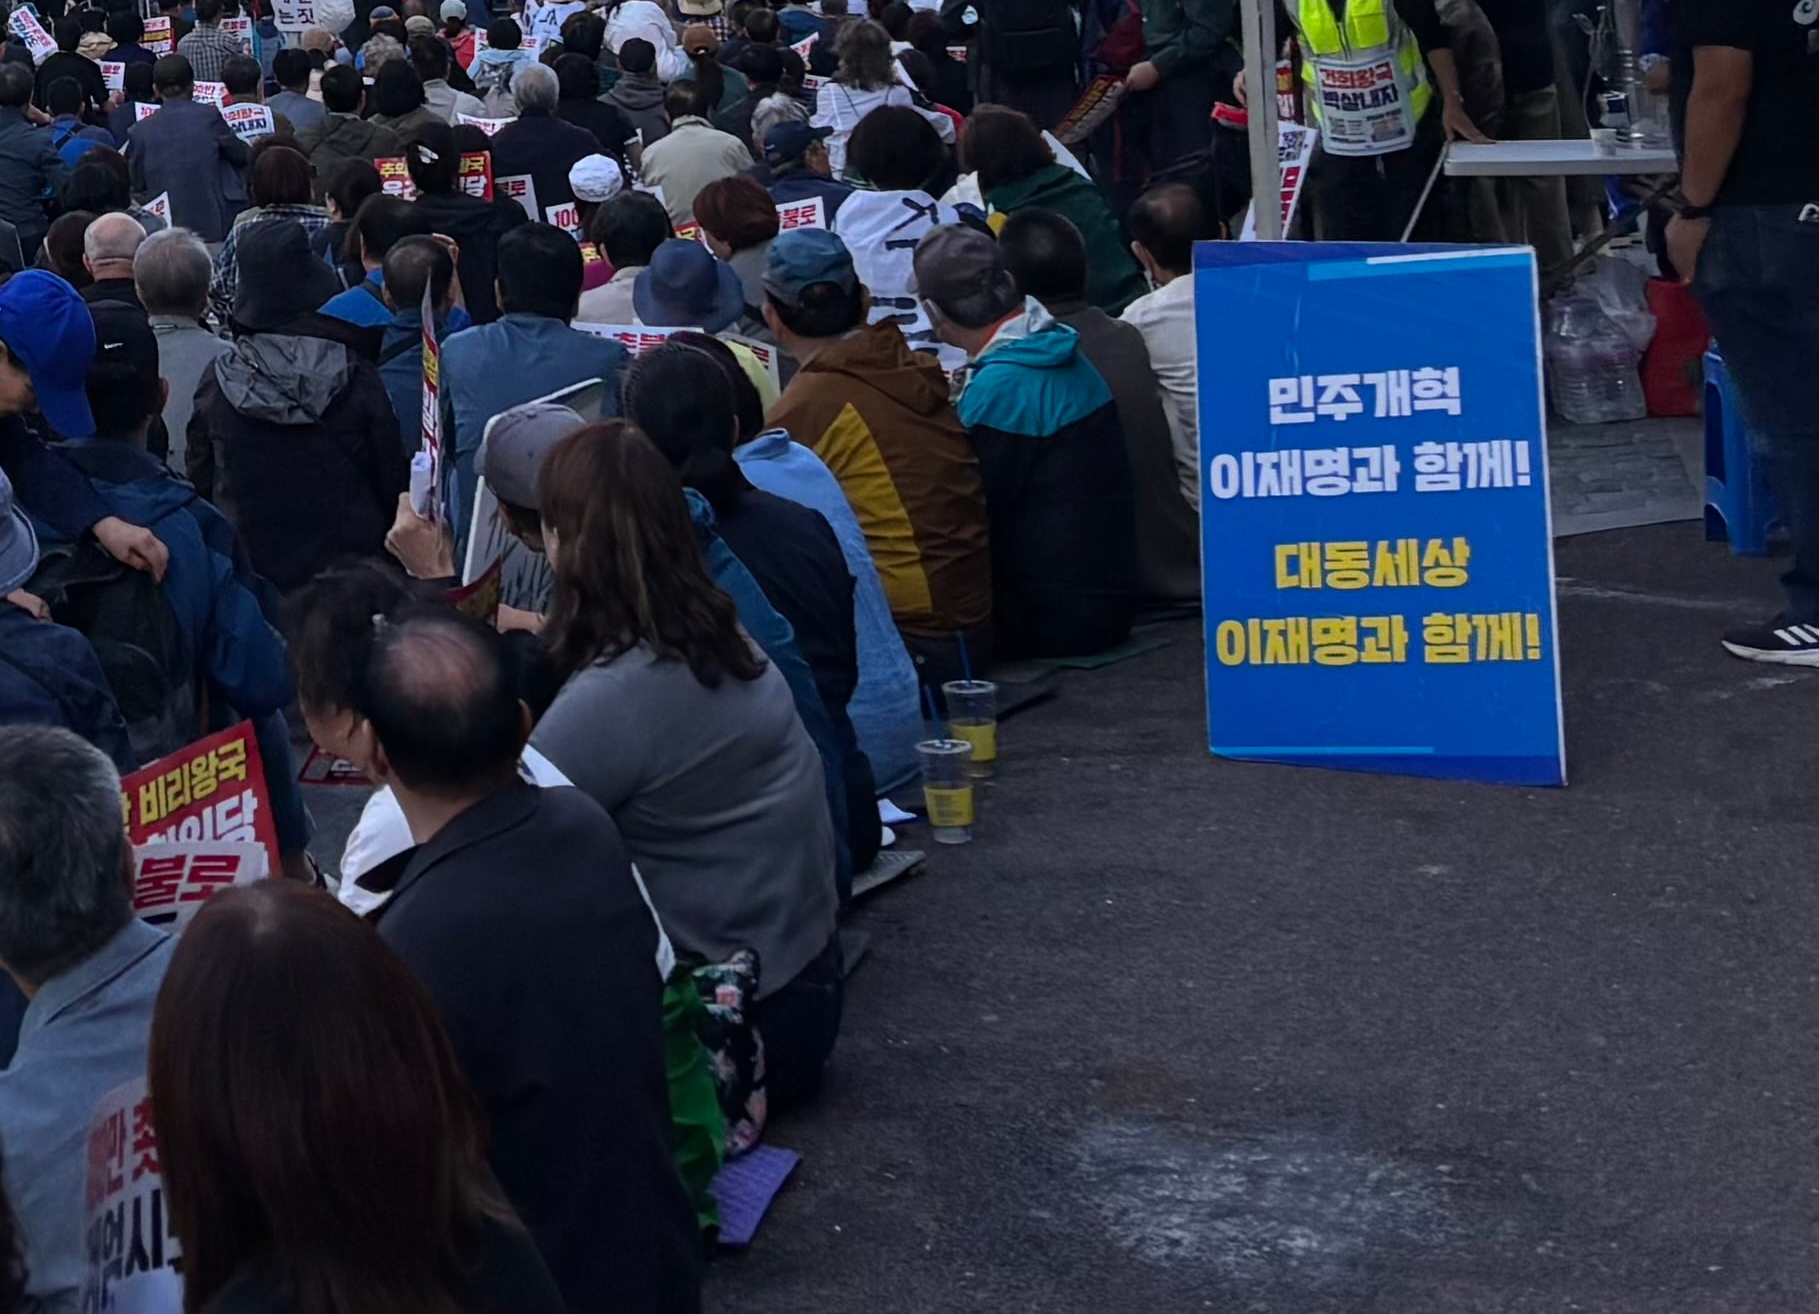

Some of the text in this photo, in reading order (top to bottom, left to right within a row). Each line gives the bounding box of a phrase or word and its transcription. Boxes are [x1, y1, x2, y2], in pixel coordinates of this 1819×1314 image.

[1268, 367, 1461, 425] 민주개혁
[1210, 440, 1532, 499] 이재명과 함께!
[1275, 537, 1471, 590] 대동세상
[1216, 612, 1541, 666] 이재명과 함께!
[139, 738, 247, 827] 비리왕국
